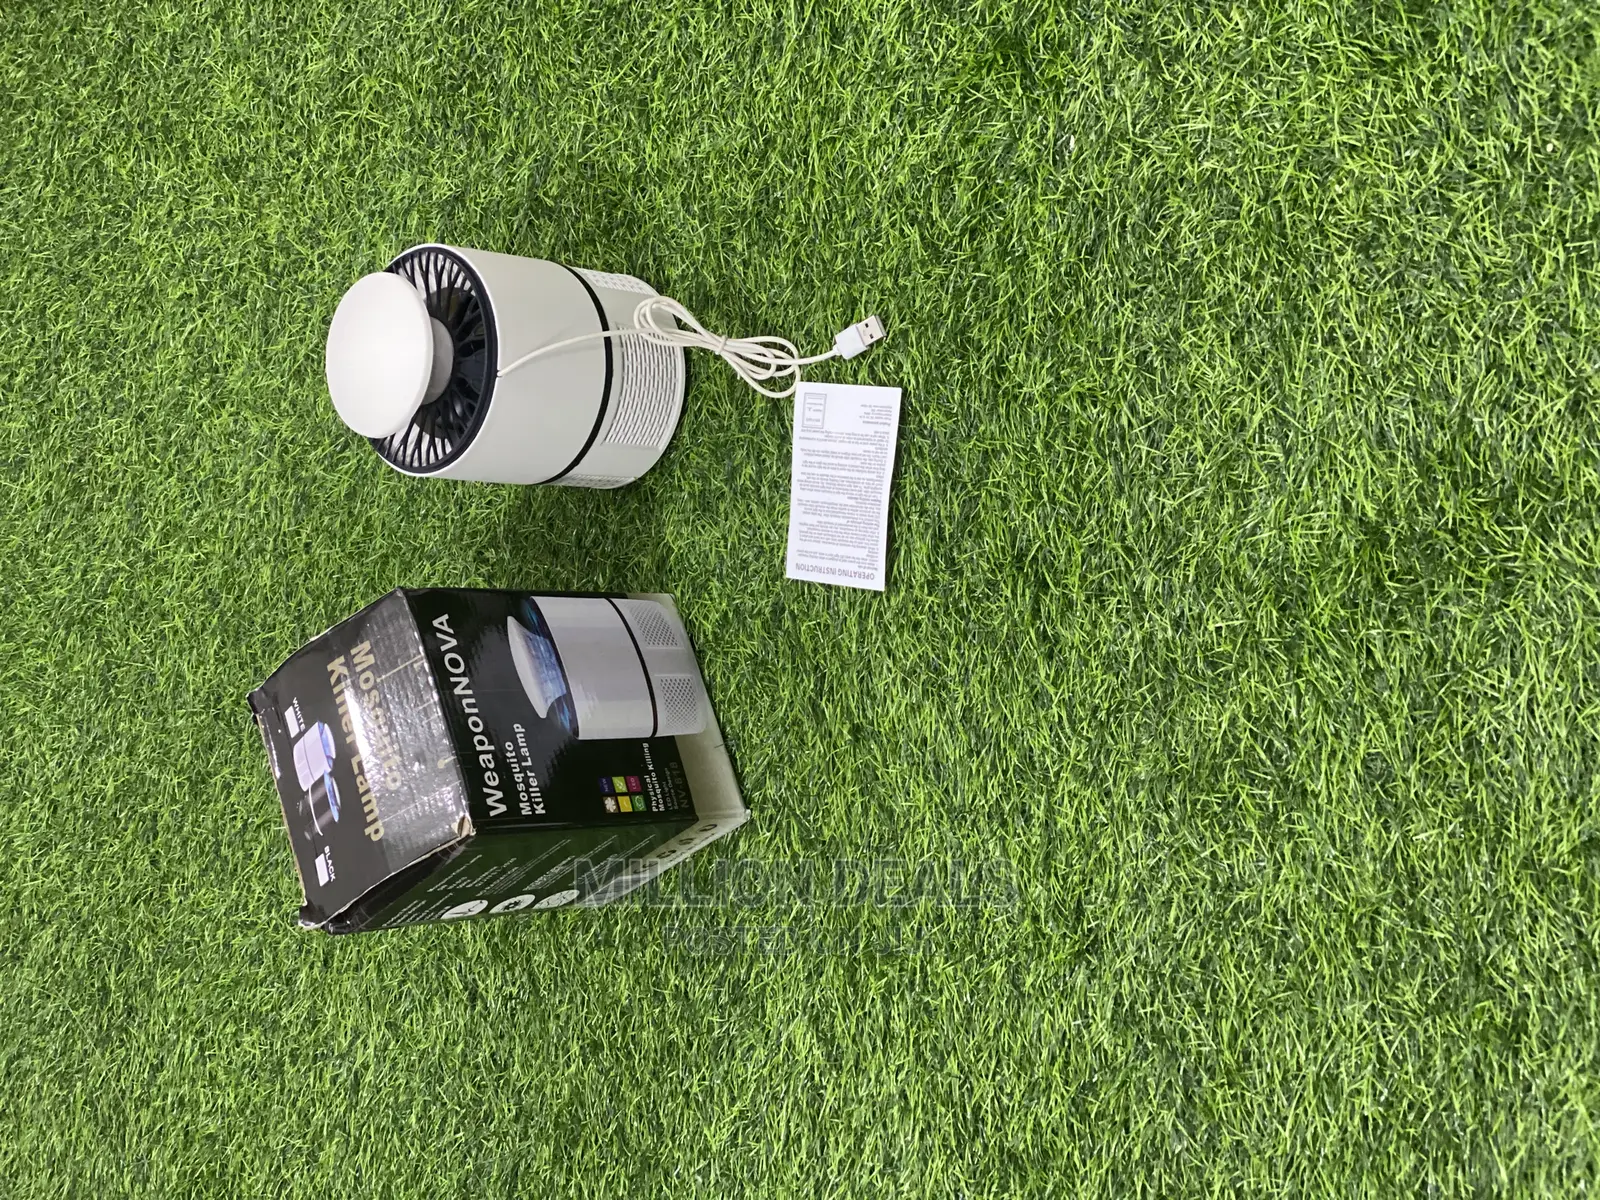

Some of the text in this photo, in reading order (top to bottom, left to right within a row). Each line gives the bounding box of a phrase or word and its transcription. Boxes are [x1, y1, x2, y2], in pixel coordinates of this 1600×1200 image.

[796, 562, 875, 580] OPERATING INSTRUCTION
[292, 697, 306, 732] WHITE
[350, 640, 402, 791] Mosquito
[432, 613, 507, 817] WeaponNOVA
[350, 751, 385, 842] Lamp
[505, 741, 532, 815] Mosquito
[513, 723, 546, 814] Killer Lamp
[642, 743, 665, 811] Mosquito Killing
[644, 775, 658, 812] Physical
[324, 846, 336, 883] BLACK
